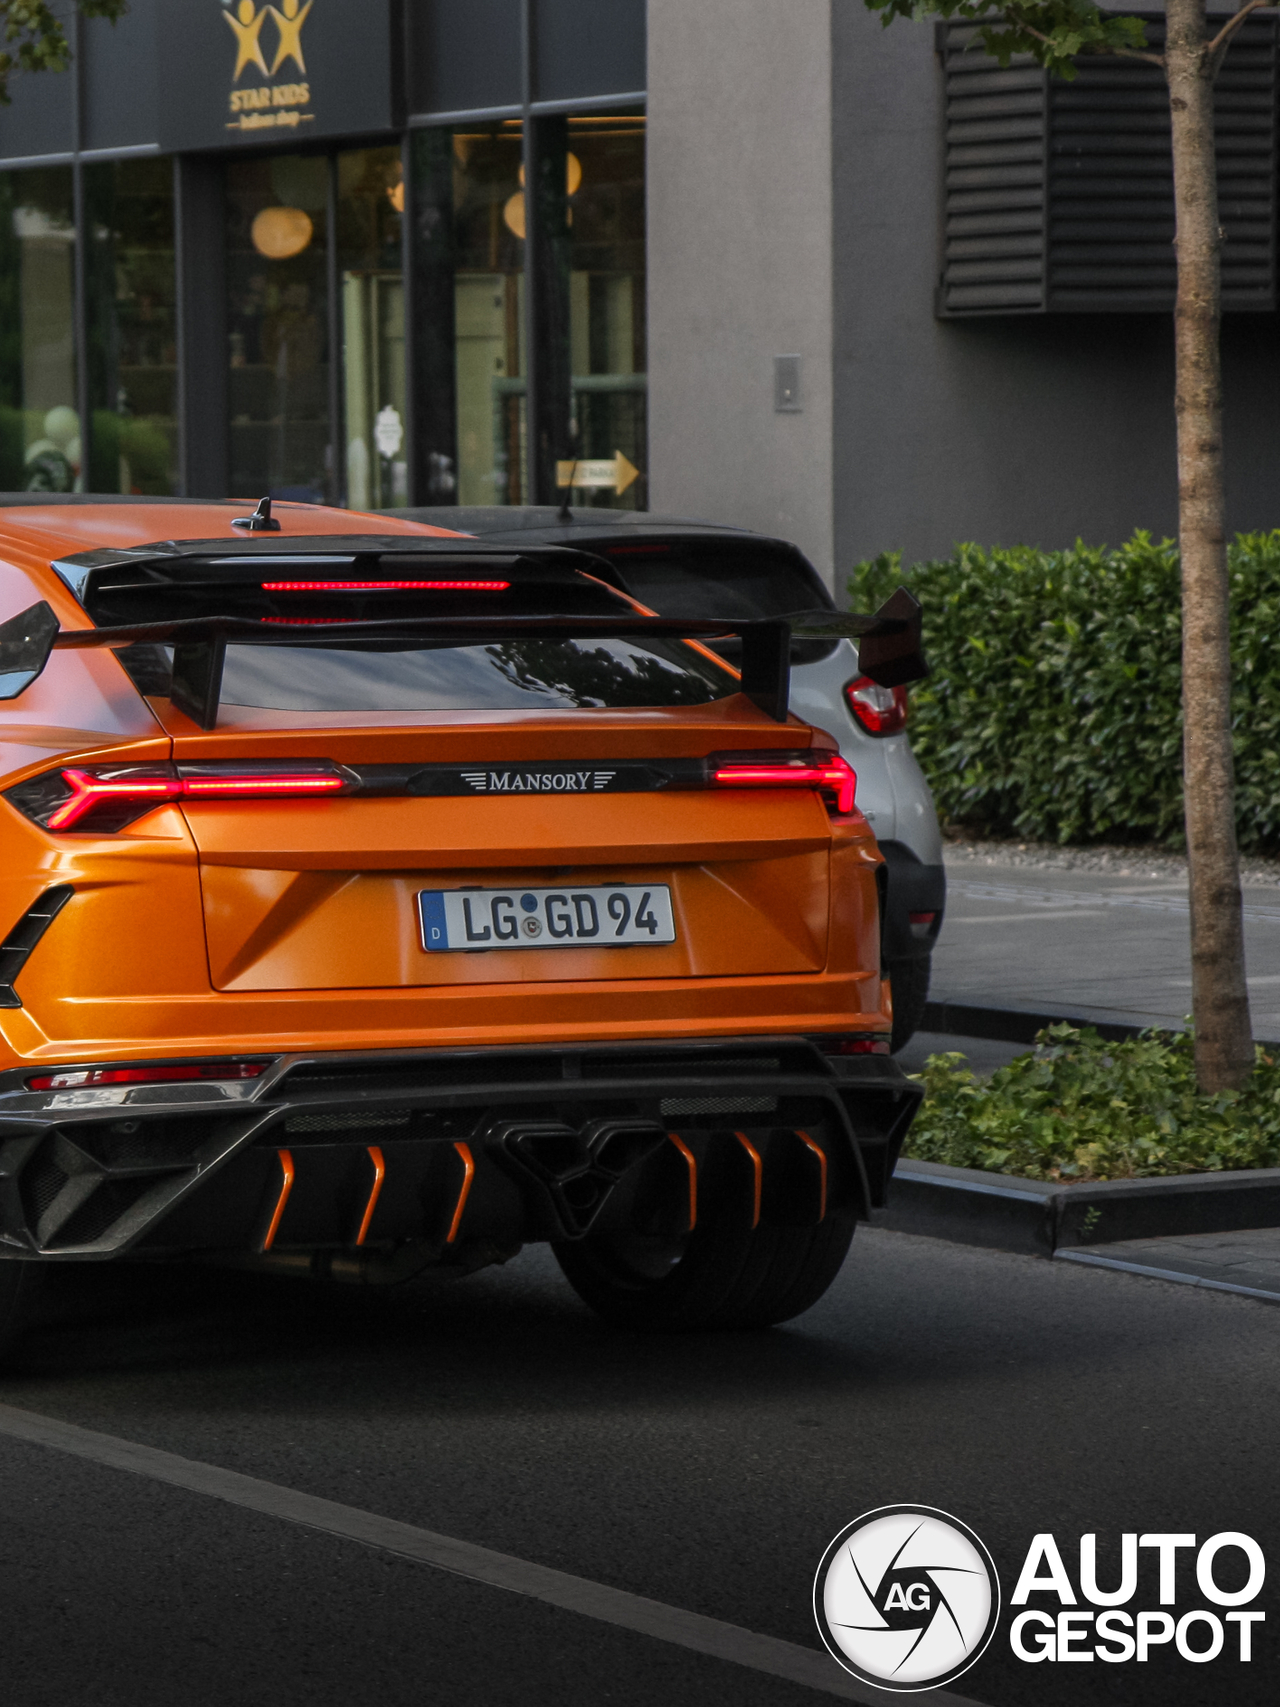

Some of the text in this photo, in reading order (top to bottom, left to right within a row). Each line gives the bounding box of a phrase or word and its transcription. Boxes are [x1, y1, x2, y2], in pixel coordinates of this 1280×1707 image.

[230, 82, 310, 112] STAR KIDS
[489, 772, 591, 790] MANSORY
[463, 892, 658, 941] LG GD 94
[431, 927, 441, 940] D
